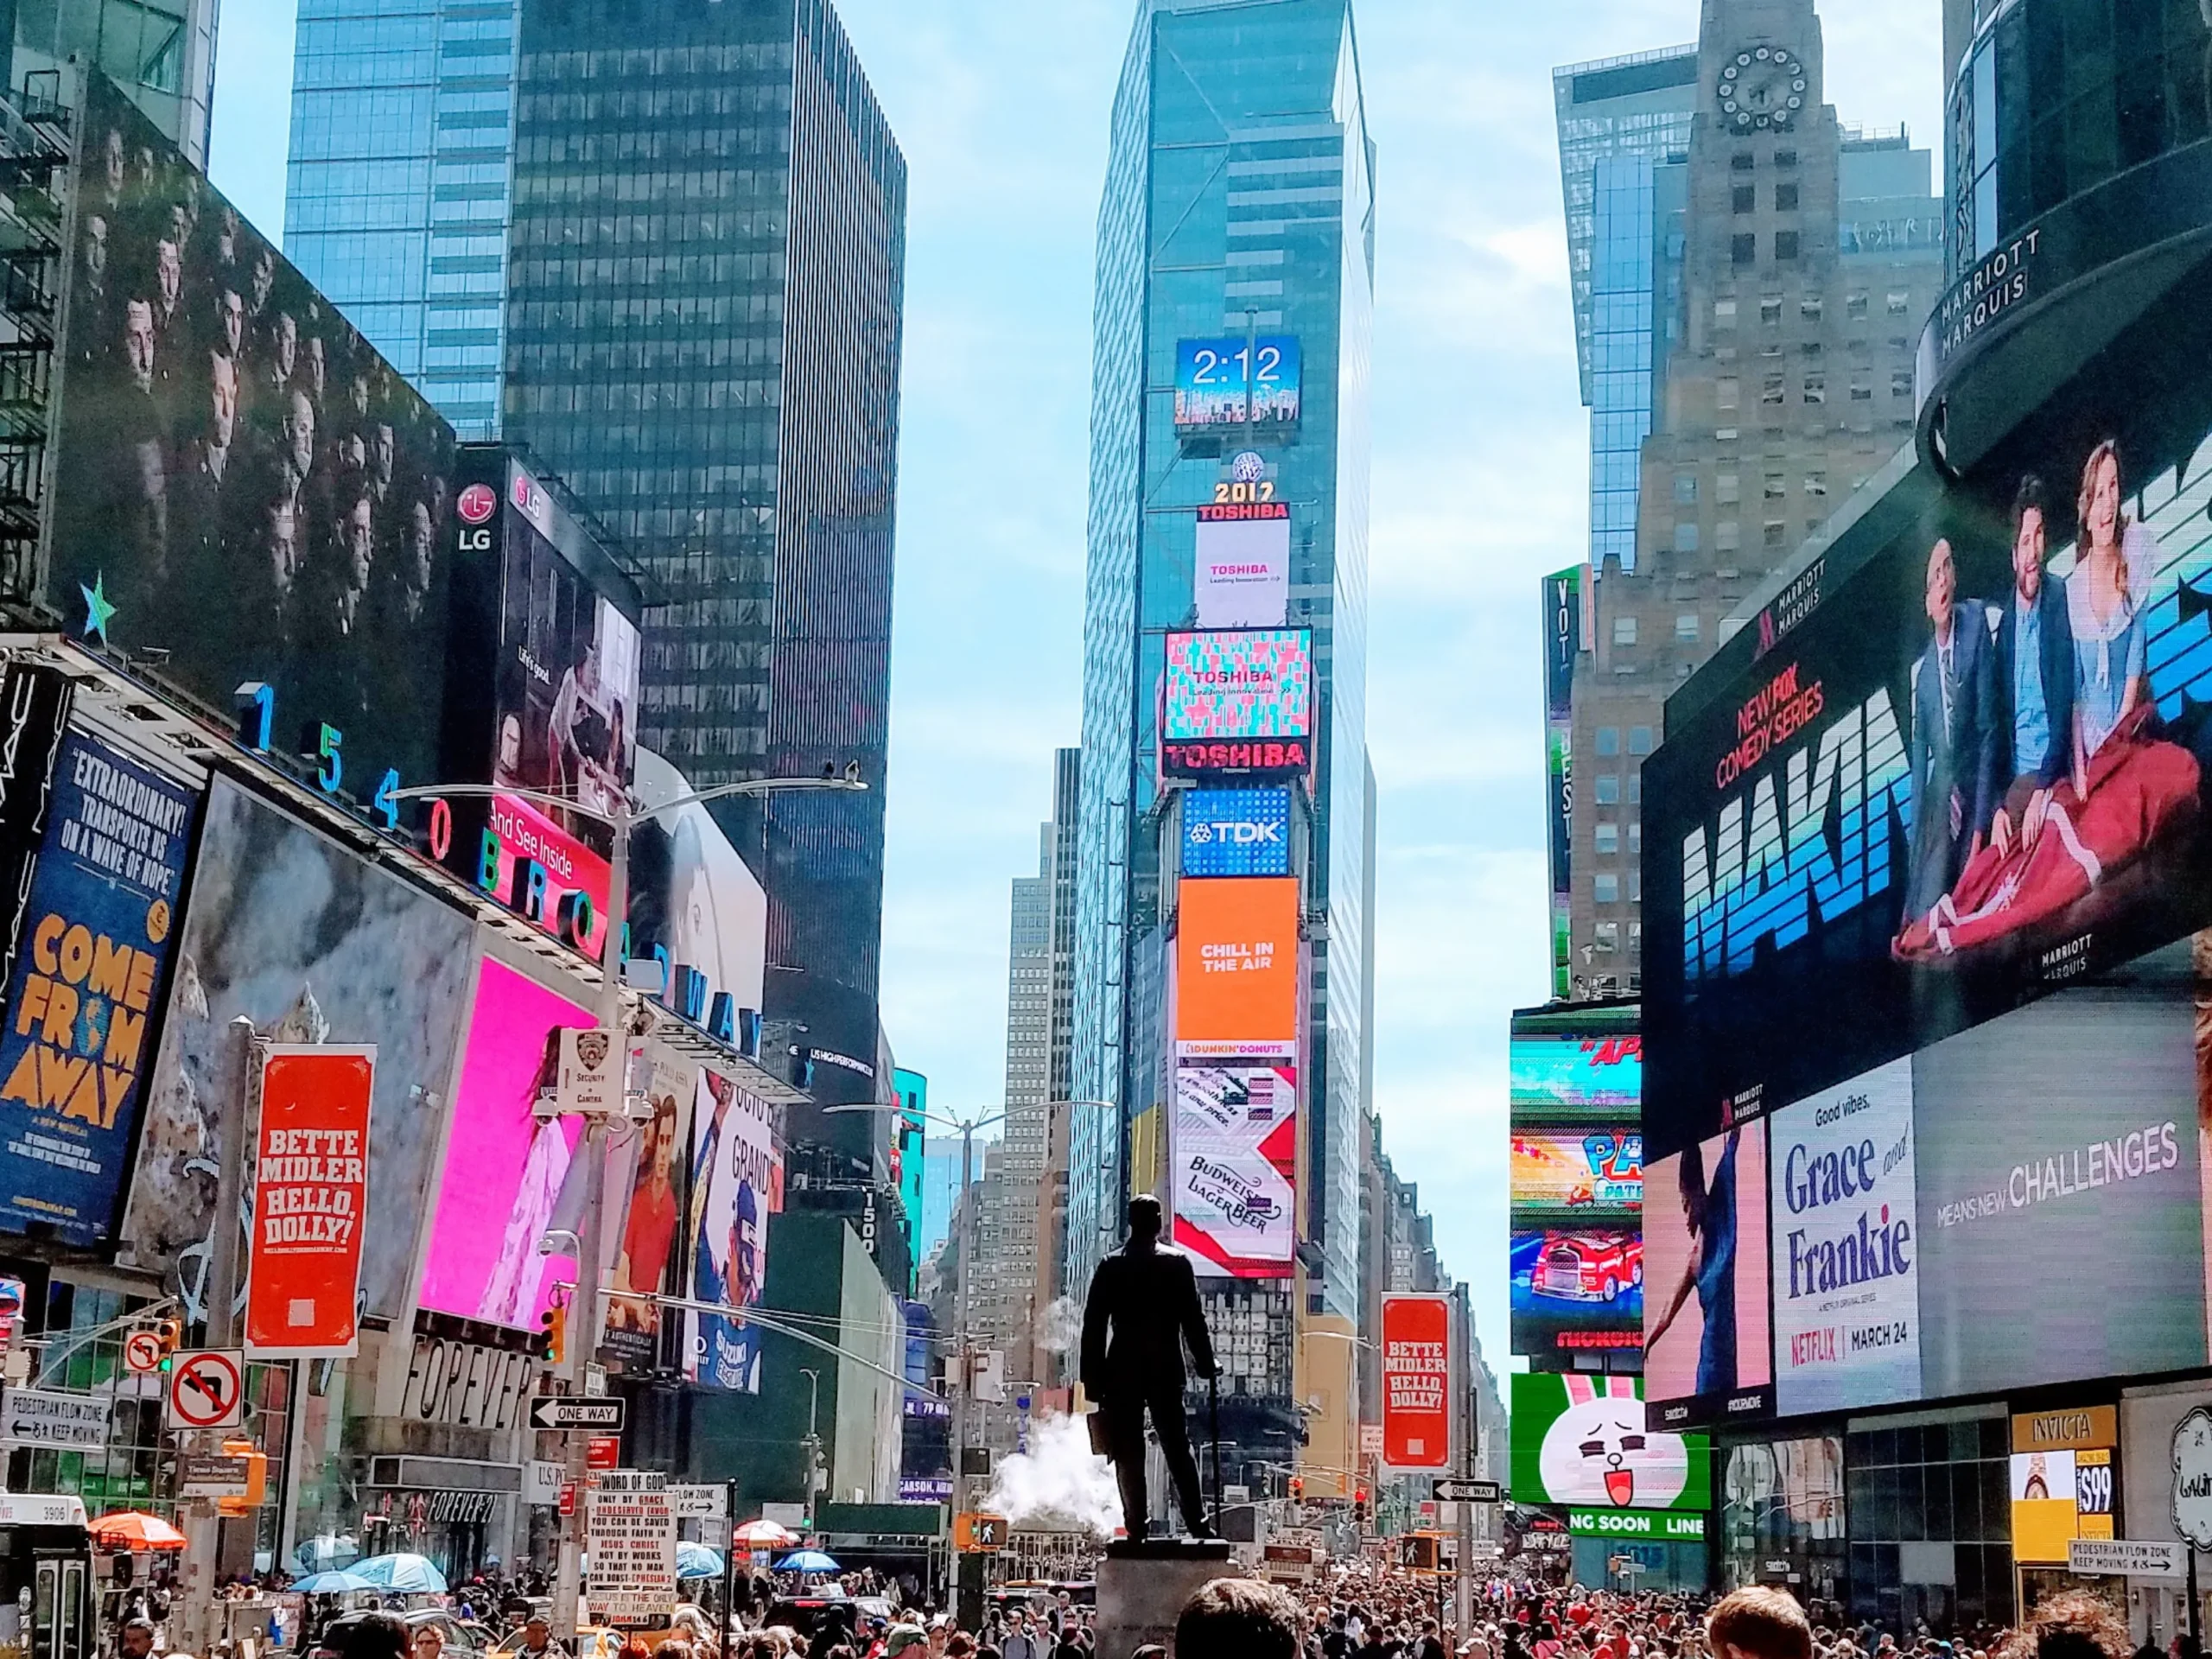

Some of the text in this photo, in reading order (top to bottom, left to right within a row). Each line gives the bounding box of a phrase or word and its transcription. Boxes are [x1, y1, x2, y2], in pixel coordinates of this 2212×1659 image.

[1942, 229, 2040, 328] MARRIOTT
[1942, 273, 2024, 359] MARQUIS
[1193, 346, 1281, 384] 2:12
[1215, 481, 1274, 504] 2017
[526, 494, 540, 518] LG
[1198, 504, 1287, 521] TOSHIBA
[458, 529, 491, 550] LG
[1211, 564, 1268, 575] TOSHIBA
[1778, 558, 1826, 613] MARRIOTT
[1778, 588, 1820, 635] MARQUIS
[1193, 671, 1273, 683] TOSHIBA
[1738, 689, 1770, 740] NEW
[1716, 681, 1824, 790] COMEDY SERIES
[1165, 743, 1307, 768] TOSHIBA
[81, 793, 168, 861] TRANSPORTS US
[1211, 821, 1281, 843] TDK
[1683, 685, 1929, 985] MAKIN
[61, 818, 80, 852] ON
[79, 828, 91, 857] A
[91, 832, 126, 874] WAVE
[126, 849, 143, 880] OF
[490, 802, 573, 880] And See Inside
[34, 912, 157, 1013] COME
[1201, 942, 1274, 958] CHILL IN
[2042, 933, 2092, 968] MARRIOTT
[1202, 957, 1272, 973] THE AIR
[0, 1041, 136, 1129] AWAY
[576, 1072, 605, 1084] SECURITY
[1815, 1092, 1870, 1127] Good vibes.
[268, 1128, 359, 1156] BETTE
[259, 1156, 364, 1184] MIDLER
[733, 1135, 769, 1196] GRAND
[1785, 1122, 1909, 1215] Grace and
[1937, 1121, 2179, 1229] MEANS NEW CHALLENGES
[1190, 1155, 1265, 1205] BUDWEIS
[266, 1187, 356, 1219] HELLO,
[1188, 1174, 1268, 1236] LAGER BEER
[264, 1215, 353, 1245] DOLLY!
[862, 1192, 875, 1254] 1500
[1787, 1203, 1911, 1300] Frankie
[716, 1328, 747, 1366] SUZUKI
[1388, 1341, 1443, 1357] BETTE
[1791, 1321, 1907, 1368] NETFLIX MARCH 24
[1384, 1357, 1447, 1373] MIDLER
[400, 1333, 532, 1431] FOREVER
[13, 1396, 102, 1422] PEDESTRIAN FLOW ZONE
[1389, 1391, 1443, 1409] DOLLY!
[558, 1408, 613, 1420] ONE WAY
[52, 1423, 70, 1440] KEEP
[2033, 1412, 2091, 1443] INVICTA
[538, 1465, 554, 1486] U.S.
[601, 1474, 627, 1491] WORD
[632, 1474, 641, 1491] OF
[646, 1474, 664, 1490] GOD
[598, 1495, 664, 1505] ONLY BY GRACE
[696, 1489, 715, 1500] ZONE
[1452, 1485, 1492, 1497] ONE WAY
[428, 1491, 481, 1523] FOREVER
[590, 1529, 666, 1538] THROUGH FAITH IN
[592, 1517, 670, 1527] YOU CAN BE SAVED
[1570, 1514, 1594, 1530] NG
[1599, 1515, 1650, 1532] SOON
[1667, 1518, 1704, 1534] LINE
[599, 1551, 661, 1560] NOT BY WORKS
[601, 1540, 659, 1548] JESUS CHRIST
[2073, 1543, 2171, 1558] PEDESTRIAN FLOW ZONE
[594, 1562, 664, 1572] SO THAT NO MAN
[2074, 1557, 2127, 1569] KEEP MOVING
[589, 1573, 603, 1582] CAN
[588, 1593, 619, 1603] JESUS
[632, 1592, 650, 1603] THE
[653, 1593, 673, 1603] ONLY
[588, 1602, 609, 1611] WAY
[613, 1602, 626, 1611] TO
[612, 1614, 632, 1624] JOHN
